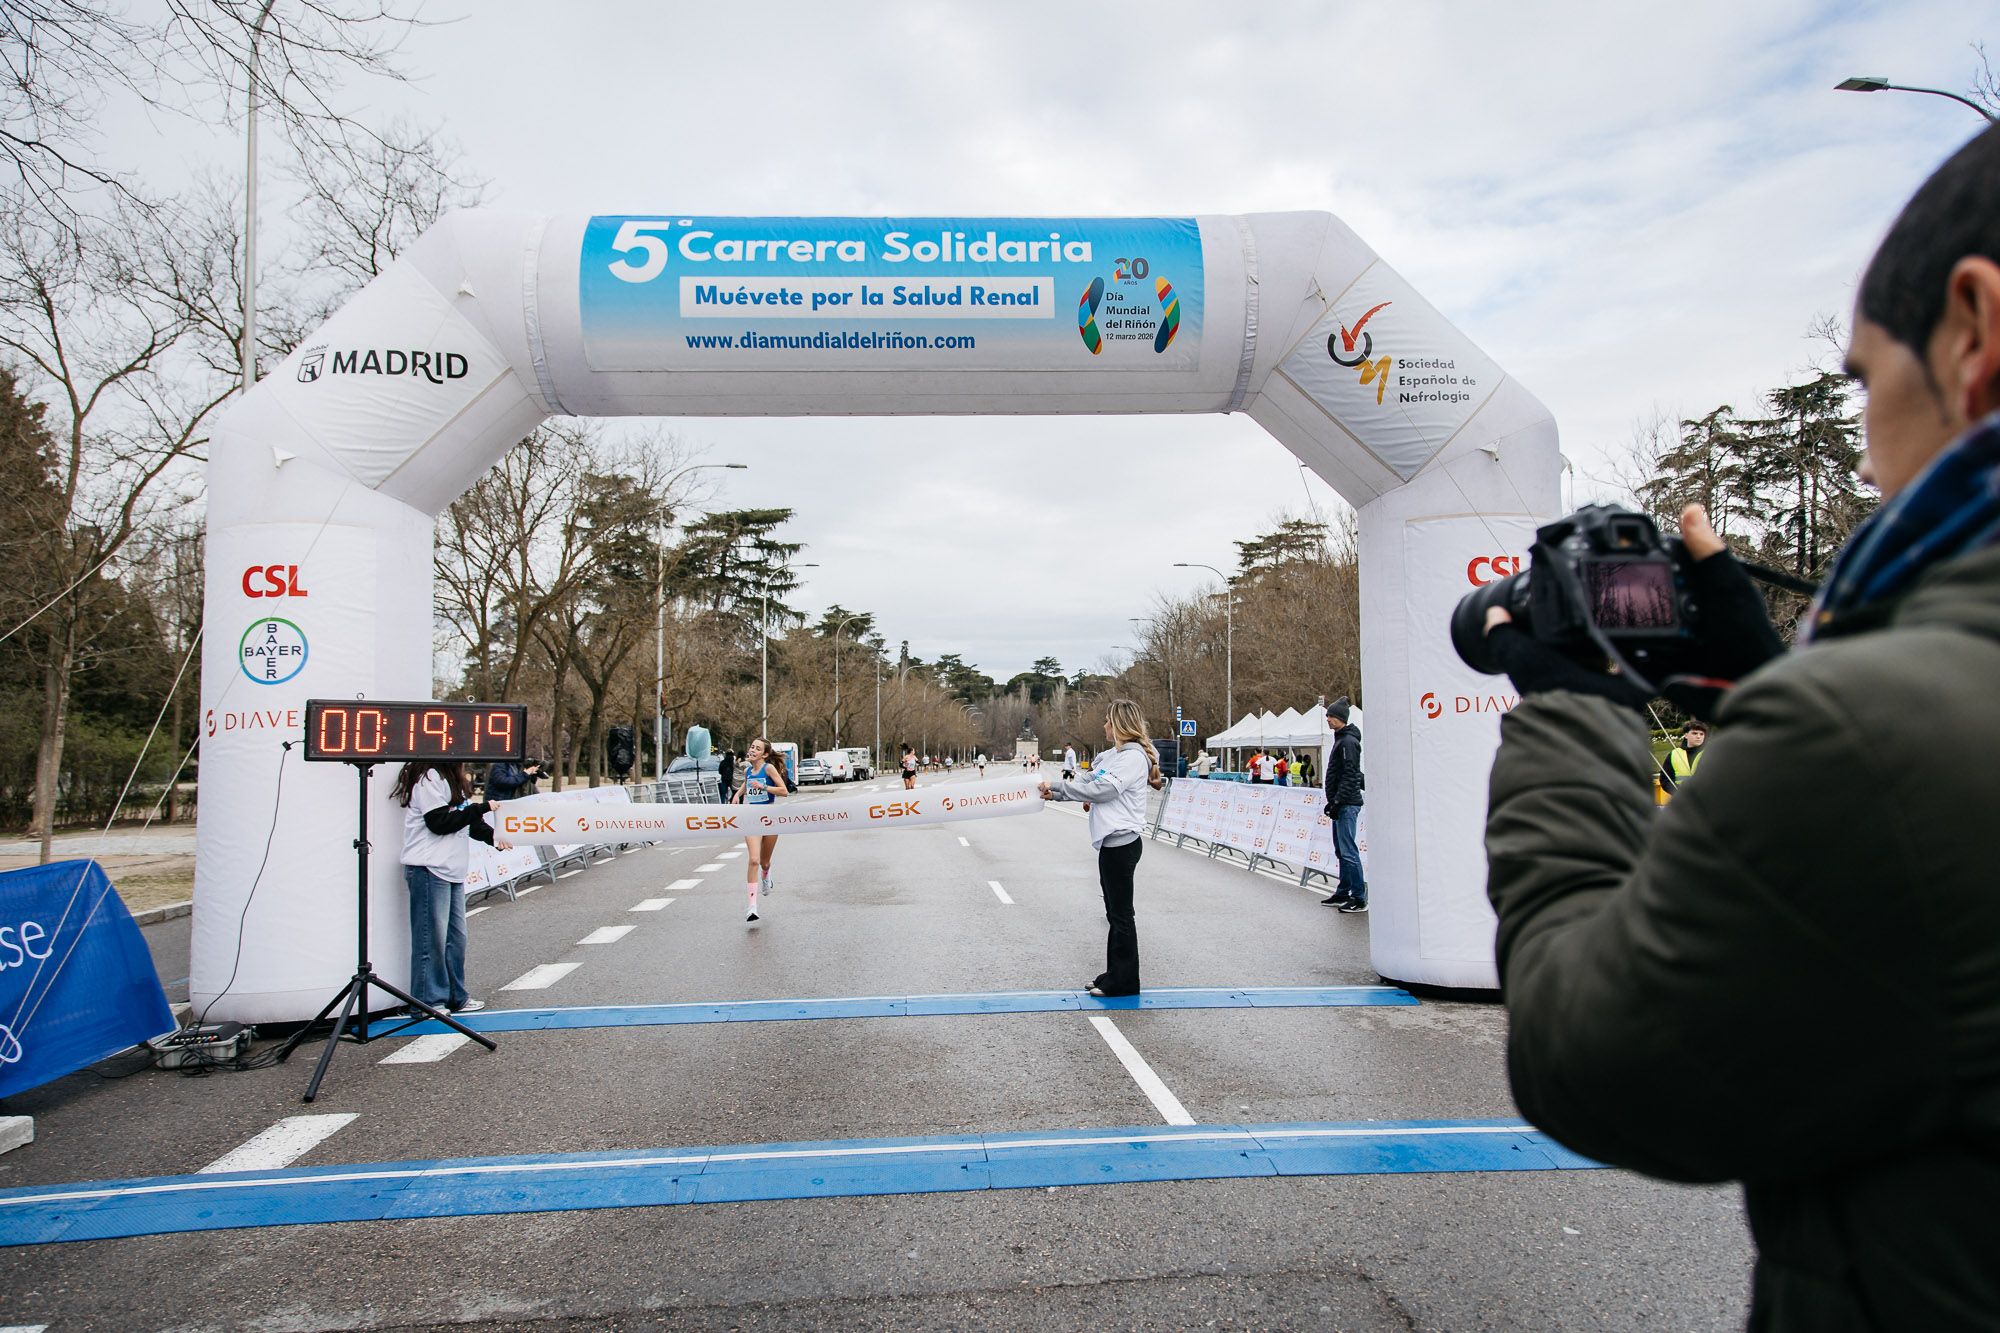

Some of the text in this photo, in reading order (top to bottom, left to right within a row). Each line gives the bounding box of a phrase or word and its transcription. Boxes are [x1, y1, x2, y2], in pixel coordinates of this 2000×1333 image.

[678, 231, 865, 262] Carrera
[882, 231, 1092, 263] Solidaria
[1113, 257, 1149, 281] 20
[695, 285, 1039, 311] Muévete por la Salud Renal
[1106, 292, 1124, 301] Día
[1106, 306, 1150, 315] Mundial
[1105, 319, 1156, 329] del Riñón
[685, 331, 975, 350] www.diamundialdelriñon.com
[332, 350, 468, 385] MADRID
[1398, 358, 1455, 369] Sociedad
[1399, 375, 1476, 388] Española de
[1399, 390, 1470, 403] Nefrología
[242, 565, 308, 598] CSL
[244, 646, 301, 657] BAYER
[265, 623, 277, 679] BAYER
[225, 710, 299, 730] DIAVE
[320, 709, 511, 752] 00:19:19
[748, 787, 763, 796] 402
[505, 790, 1028, 832] GSK DIAVERUM GSK DIAVERUM GSK DIAVERUM
[0, 921, 54, 972] se
